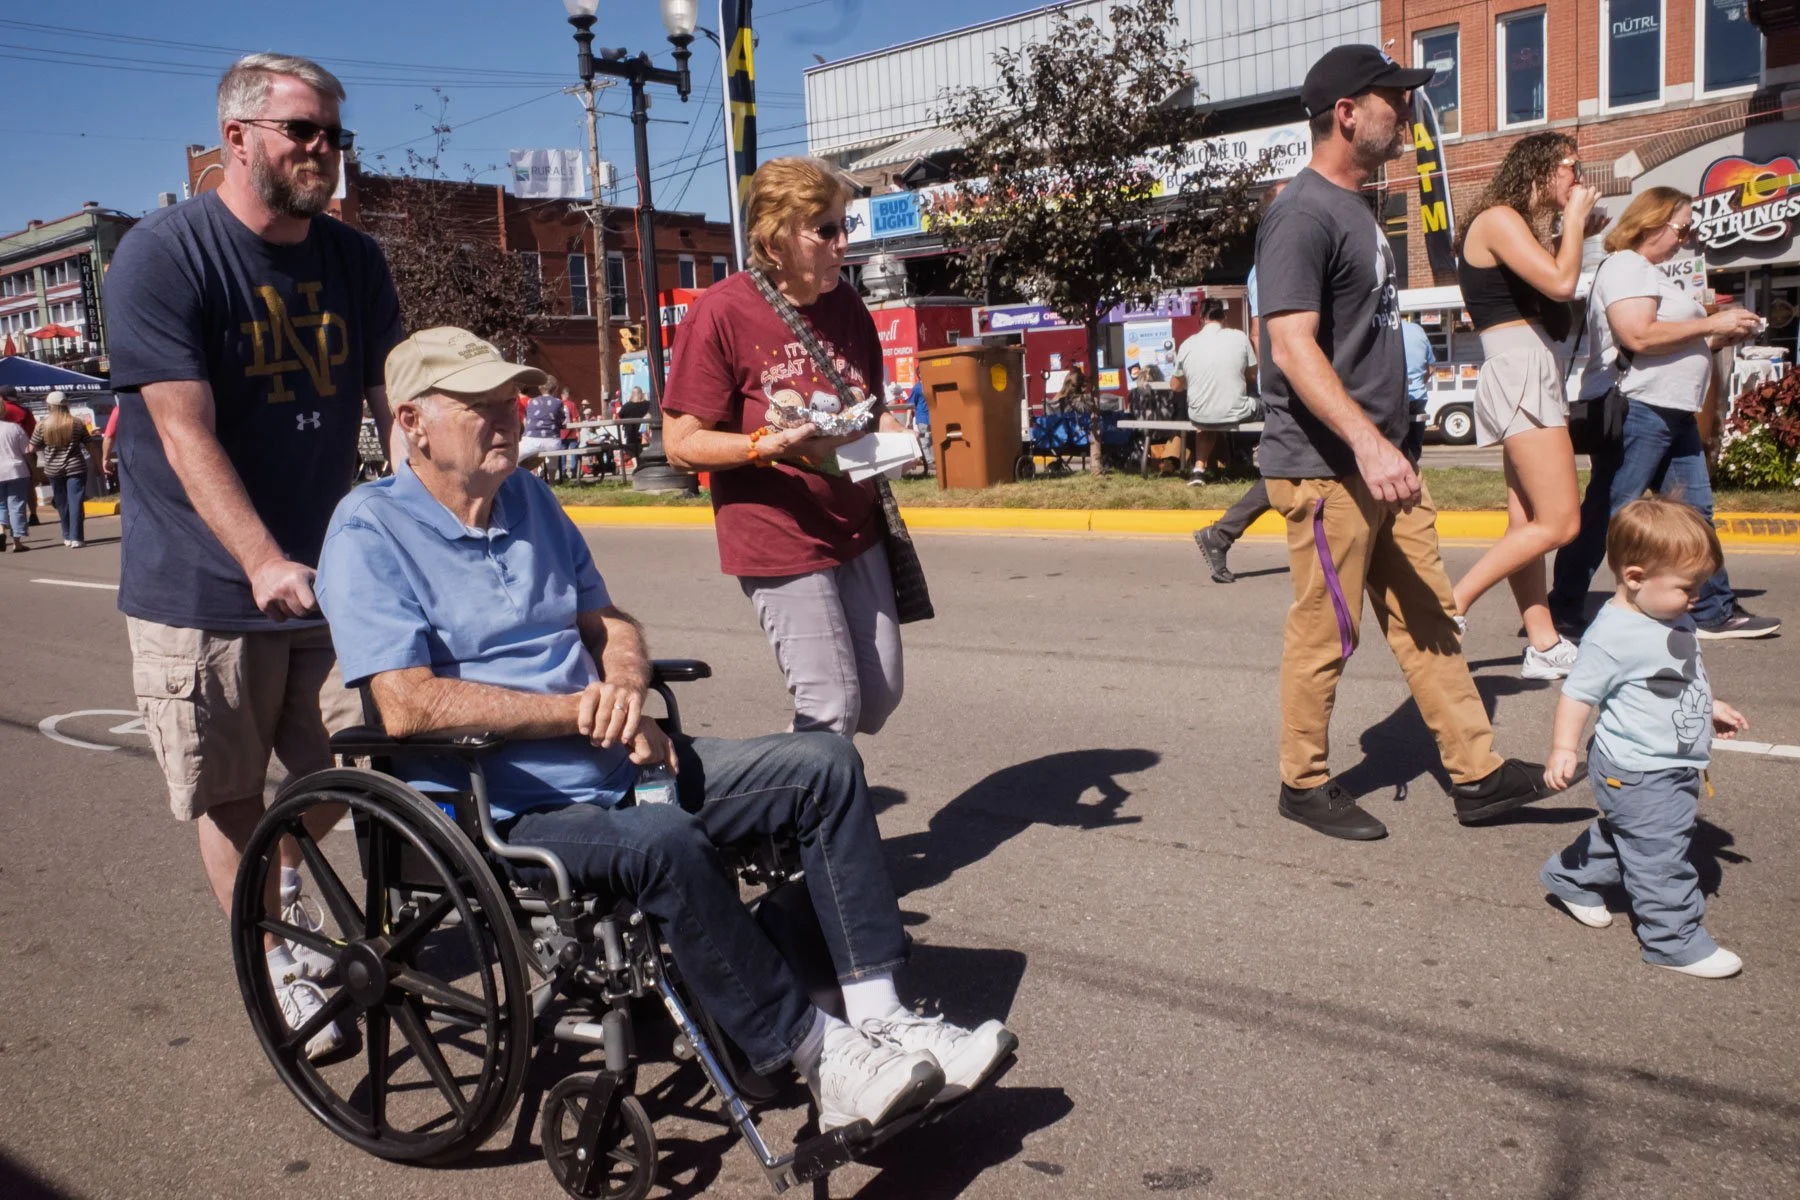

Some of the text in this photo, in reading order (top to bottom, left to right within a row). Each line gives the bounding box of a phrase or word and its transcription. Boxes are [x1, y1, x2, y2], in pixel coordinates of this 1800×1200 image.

[1232, 140, 1247, 160] TO
[532, 166, 567, 176] RURAL
[1414, 122, 1448, 234] ATM
[879, 198, 910, 216] BUD
[1690, 190, 1737, 231] SIX
[874, 212, 915, 232] LIGHT
[1698, 195, 1800, 248] STRINGS
[662, 305, 687, 324] ATM
[761, 358, 805, 384] GREAT
